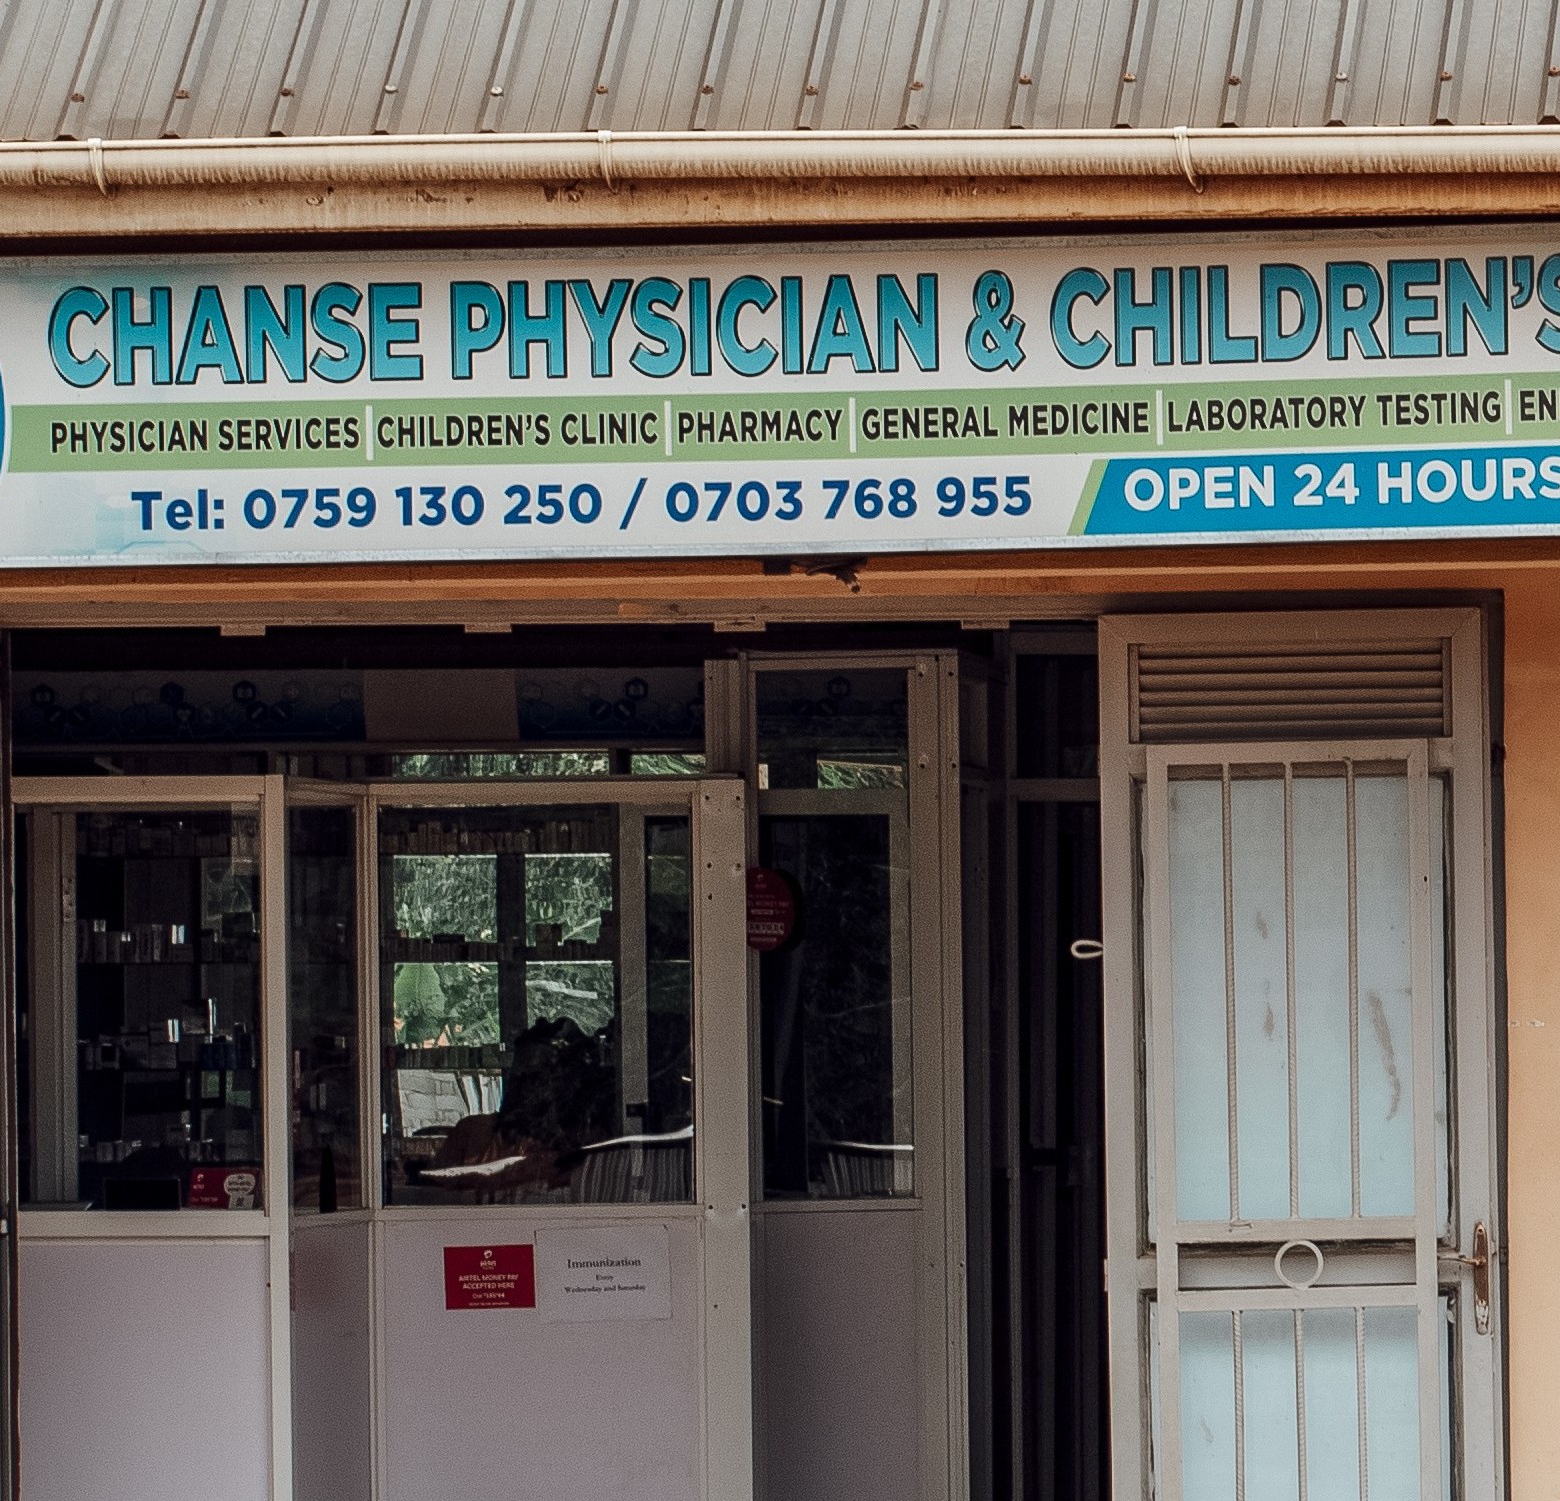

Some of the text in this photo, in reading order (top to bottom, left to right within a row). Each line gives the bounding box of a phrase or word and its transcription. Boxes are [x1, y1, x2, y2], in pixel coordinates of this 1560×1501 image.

[48, 281, 425, 388] CHANSE
[451, 271, 939, 384] PHYSICIAN
[965, 268, 1027, 372] &
[51, 418, 211, 455] PHYSICIAN
[218, 416, 361, 452] SERVICES
[376, 414, 551, 449] CHILDREN'S
[559, 411, 659, 446] CLINIC
[677, 407, 842, 444] PHARMACY
[860, 404, 1002, 440] GENERAL
[1007, 402, 1150, 437] MEDICINE
[1166, 396, 1365, 433] LABORATORY
[1376, 394, 1501, 427] TESTING
[131, 472, 1033, 531] Tel: 0759 130 250 / 0703 768 955
[1123, 464, 1277, 512] OPEN
[1291, 462, 1360, 507] 24
[566, 1258, 642, 1269] Immunization
